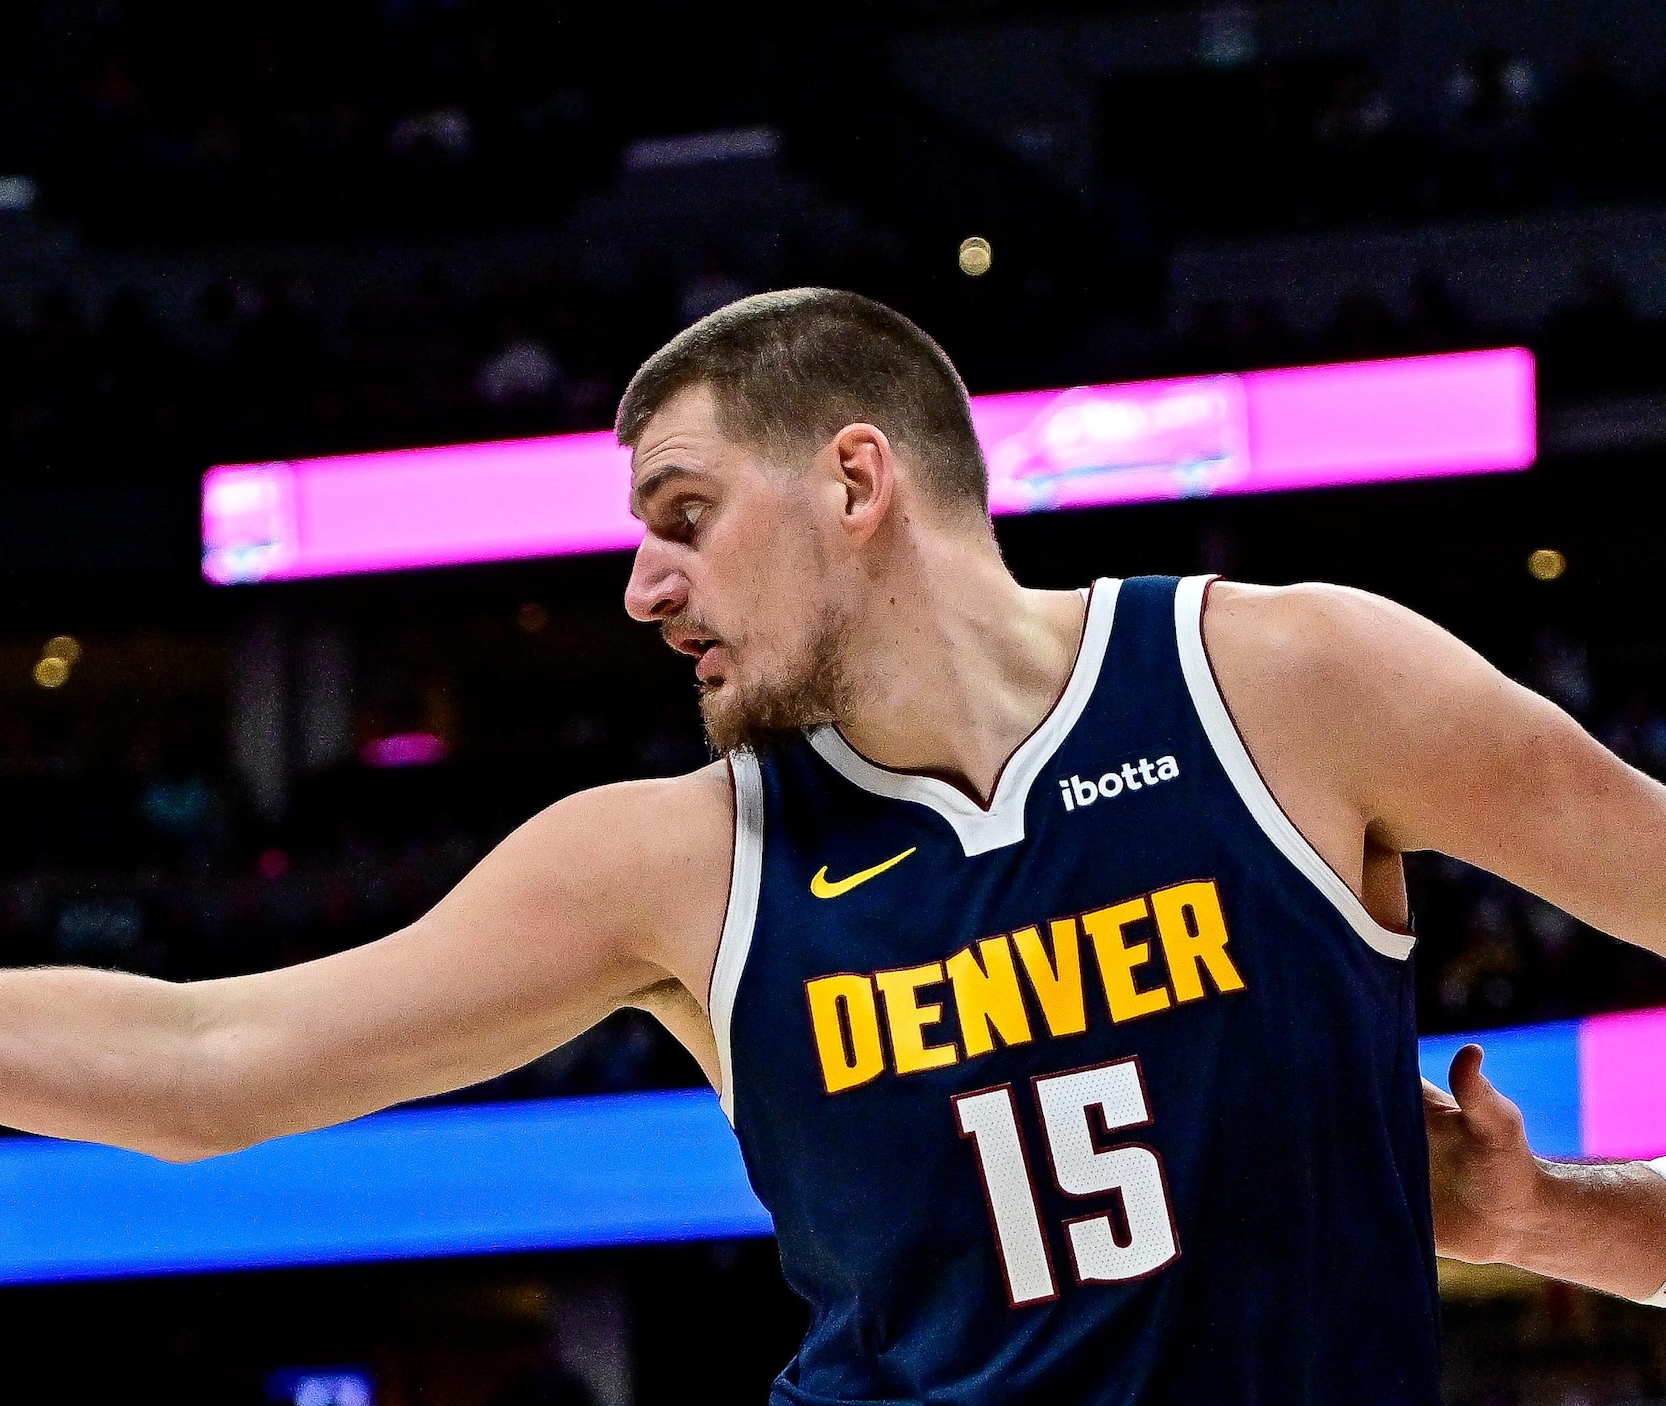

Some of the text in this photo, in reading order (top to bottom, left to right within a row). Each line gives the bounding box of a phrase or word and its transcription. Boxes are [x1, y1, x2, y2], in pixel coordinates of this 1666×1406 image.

[1059, 755, 1180, 812] ibotta
[804, 877, 1248, 1094] DENVER
[950, 1055, 1181, 1307] 15
